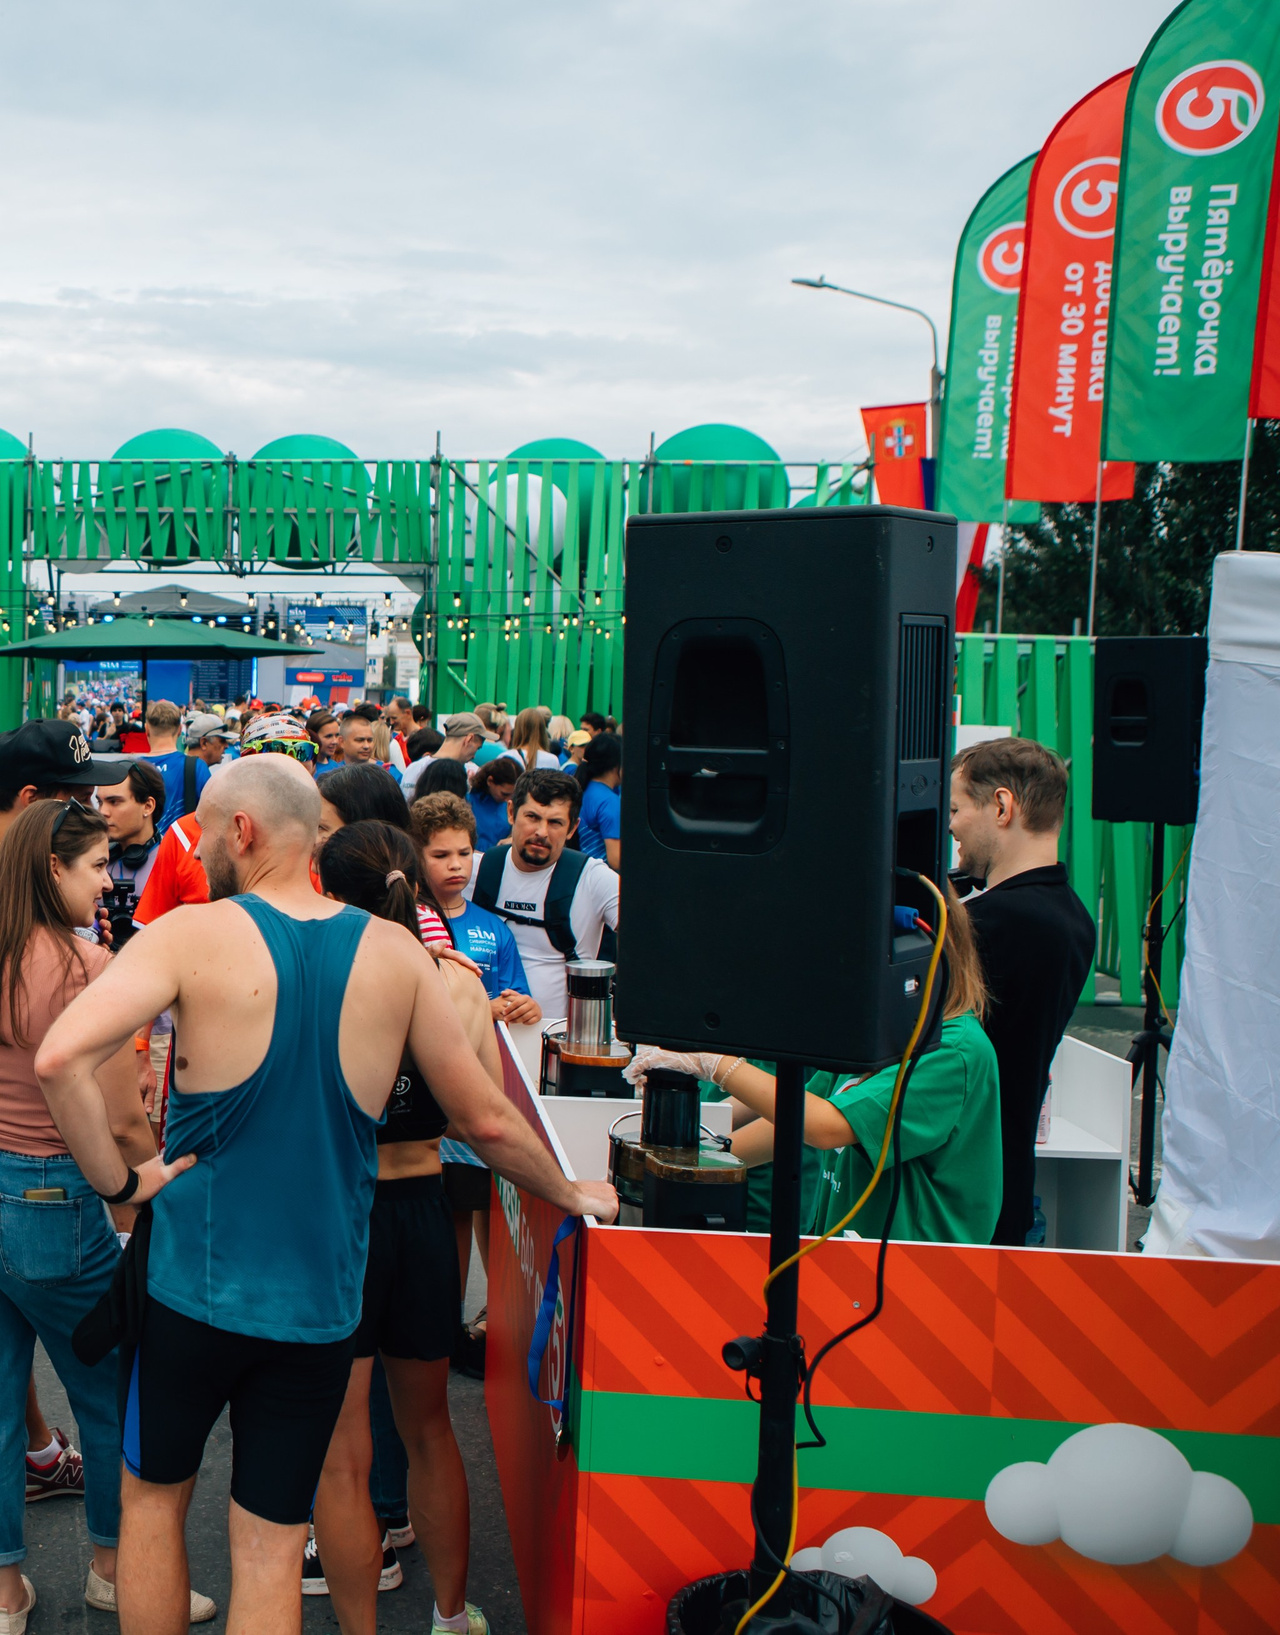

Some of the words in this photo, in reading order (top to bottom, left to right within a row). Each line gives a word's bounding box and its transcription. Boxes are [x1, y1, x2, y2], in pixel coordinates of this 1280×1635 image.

[1176, 86, 1255, 133] 5
[1071, 178, 1119, 218] 5
[1060, 303, 1086, 337] 30
[1153, 186, 1193, 376] выручает!
[1193, 184, 1239, 376] Пятёрочка
[972, 315, 1002, 460] выручает!
